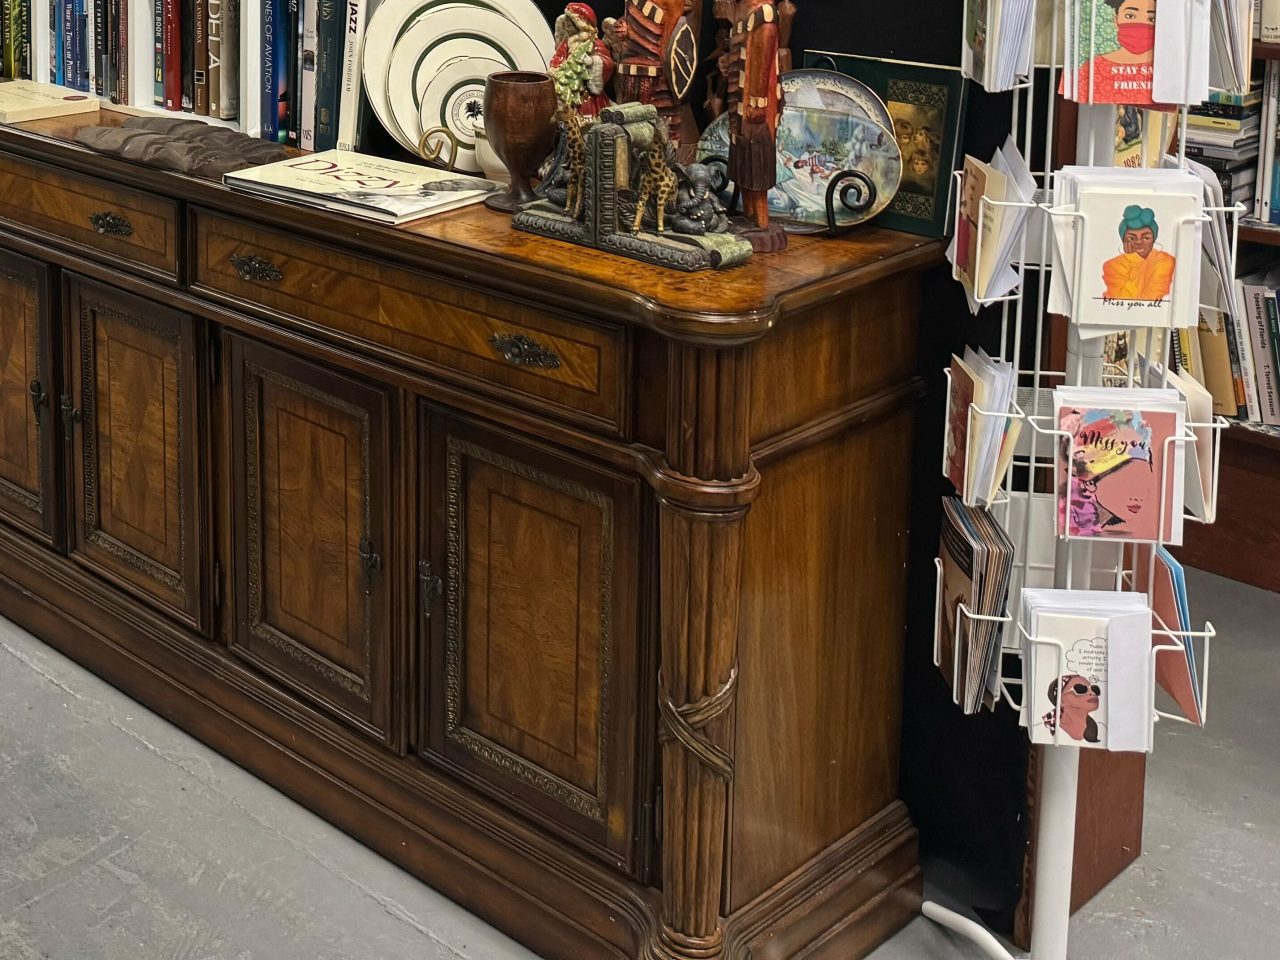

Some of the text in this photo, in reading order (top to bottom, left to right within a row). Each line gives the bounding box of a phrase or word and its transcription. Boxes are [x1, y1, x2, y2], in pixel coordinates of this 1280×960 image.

[155, 18, 163, 37] BOOK
[265, 18, 272, 34] OF
[349, 2, 359, 34] JAZZ
[264, 37, 272, 93] AVIATION
[1111, 66, 1138, 74] STAY
[1102, 297, 1163, 309] Miss you all
[1253, 293, 1261, 319] Speaking
[1258, 319, 1263, 329] of
[1078, 429, 1150, 455] Miss you
